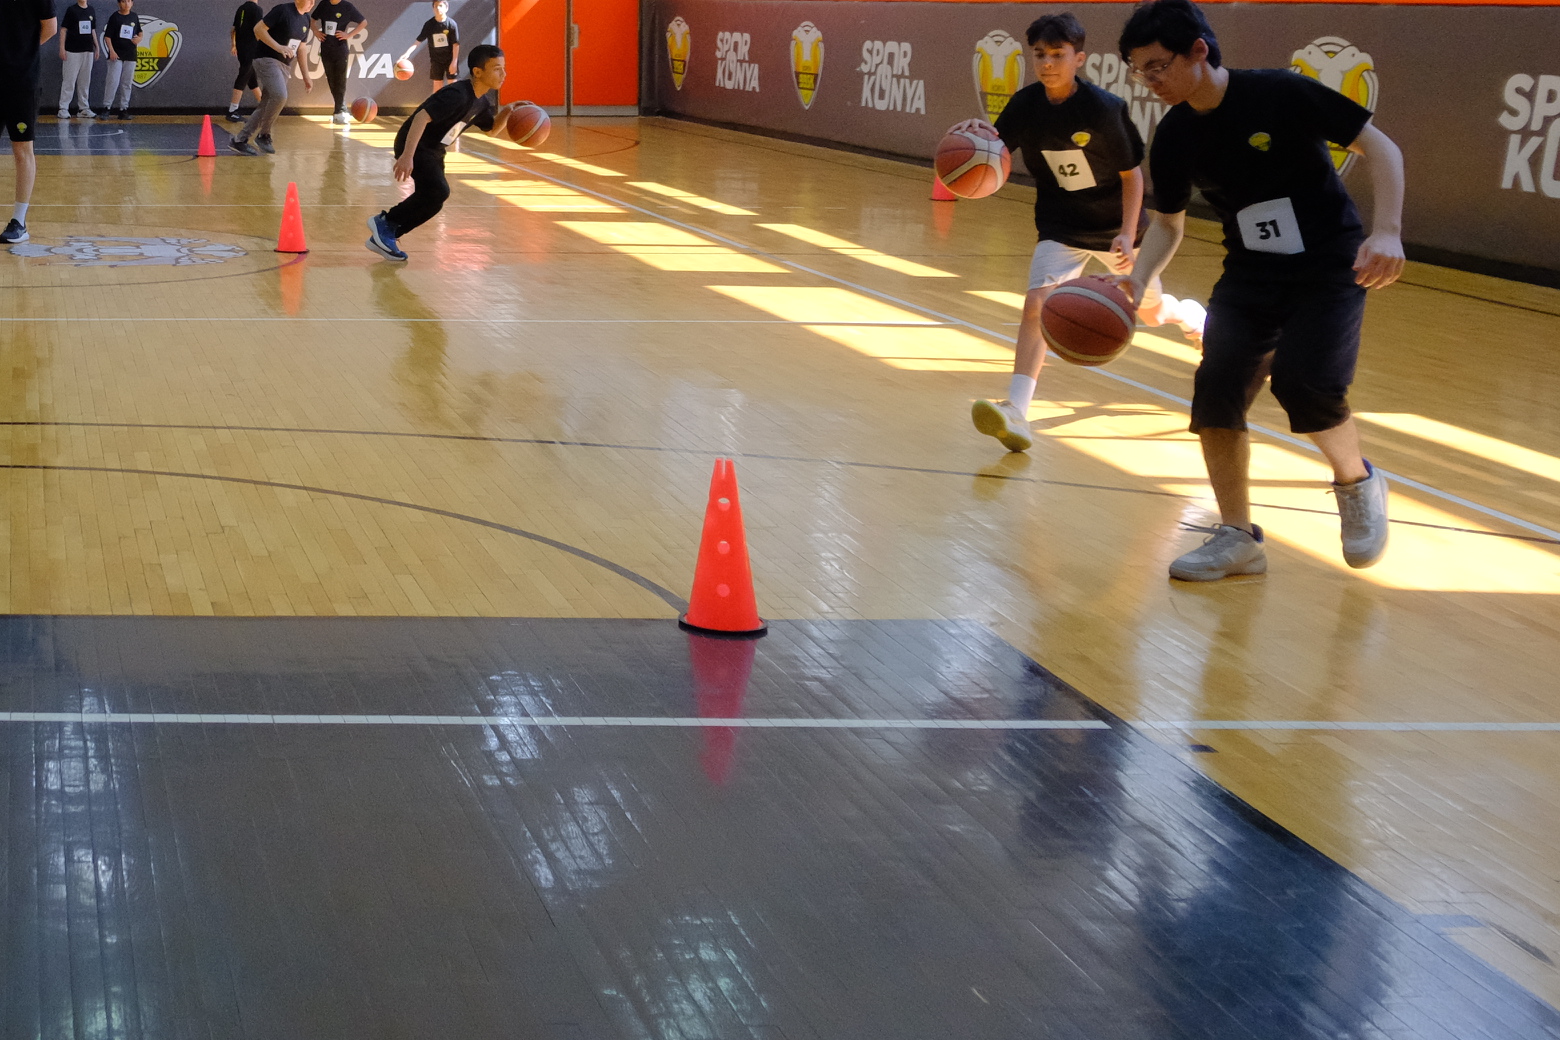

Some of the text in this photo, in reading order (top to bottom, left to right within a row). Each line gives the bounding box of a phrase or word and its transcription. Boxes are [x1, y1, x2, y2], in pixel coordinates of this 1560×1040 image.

[715, 31, 751, 60] SPOR
[860, 40, 912, 77] SPOR
[715, 53, 760, 92] KONYA
[861, 66, 926, 115] KONYA
[1498, 73, 1560, 131] SP
[1058, 163, 1080, 177] 42
[1255, 219, 1282, 240] 31
